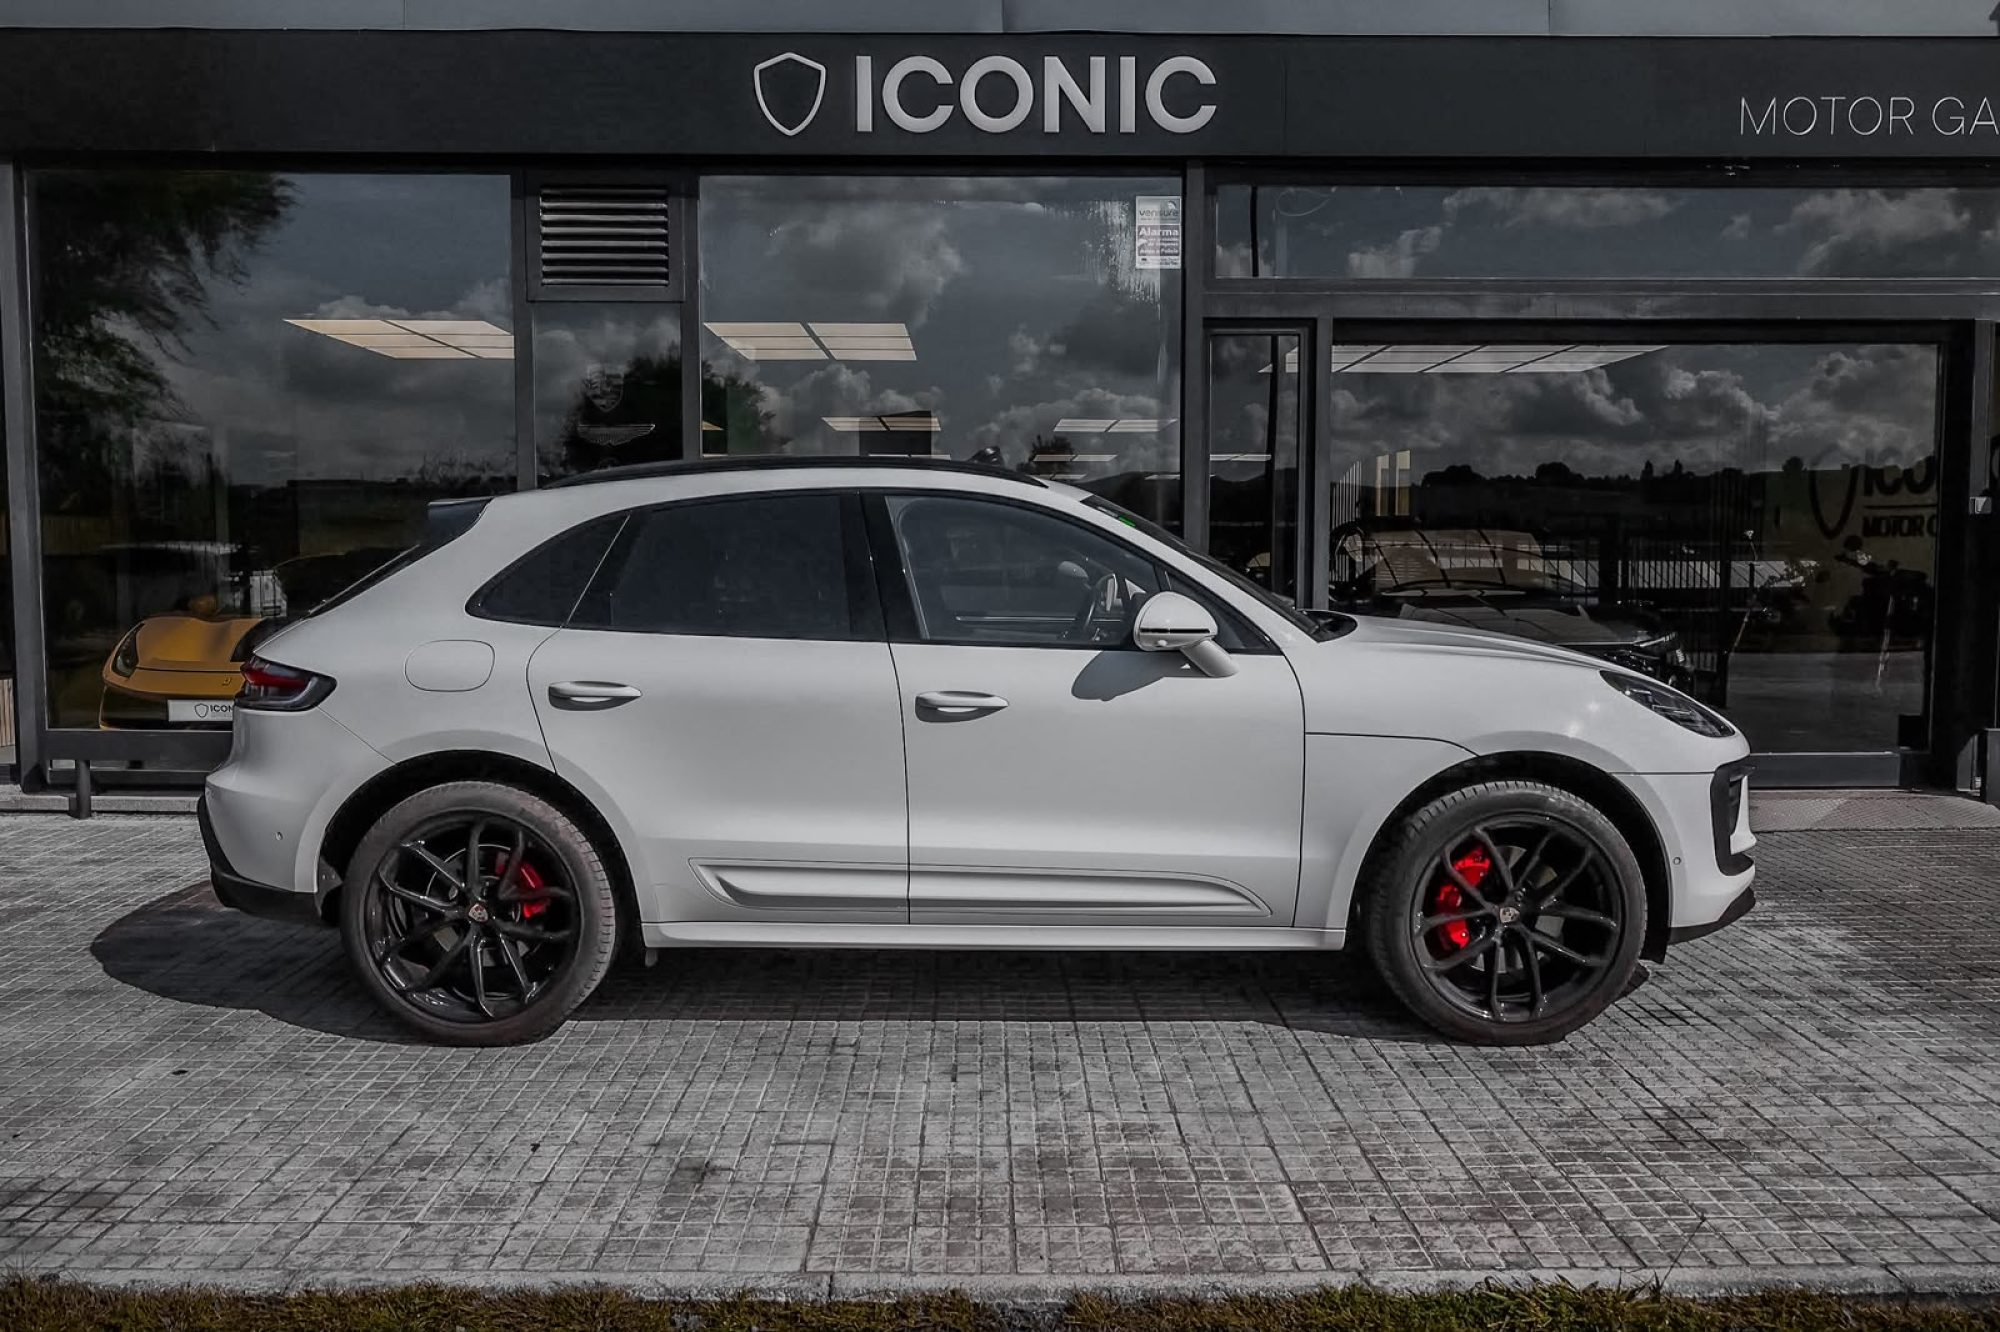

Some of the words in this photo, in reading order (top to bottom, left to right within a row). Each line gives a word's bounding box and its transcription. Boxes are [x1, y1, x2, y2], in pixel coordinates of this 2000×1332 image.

[855, 55, 1217, 133] ICONIC
[1740, 96, 1914, 135] MOTOR
[1931, 96, 2000, 135] GA
[1139, 227, 1179, 236] Alarma
[1863, 516, 1924, 537] MOTOR
